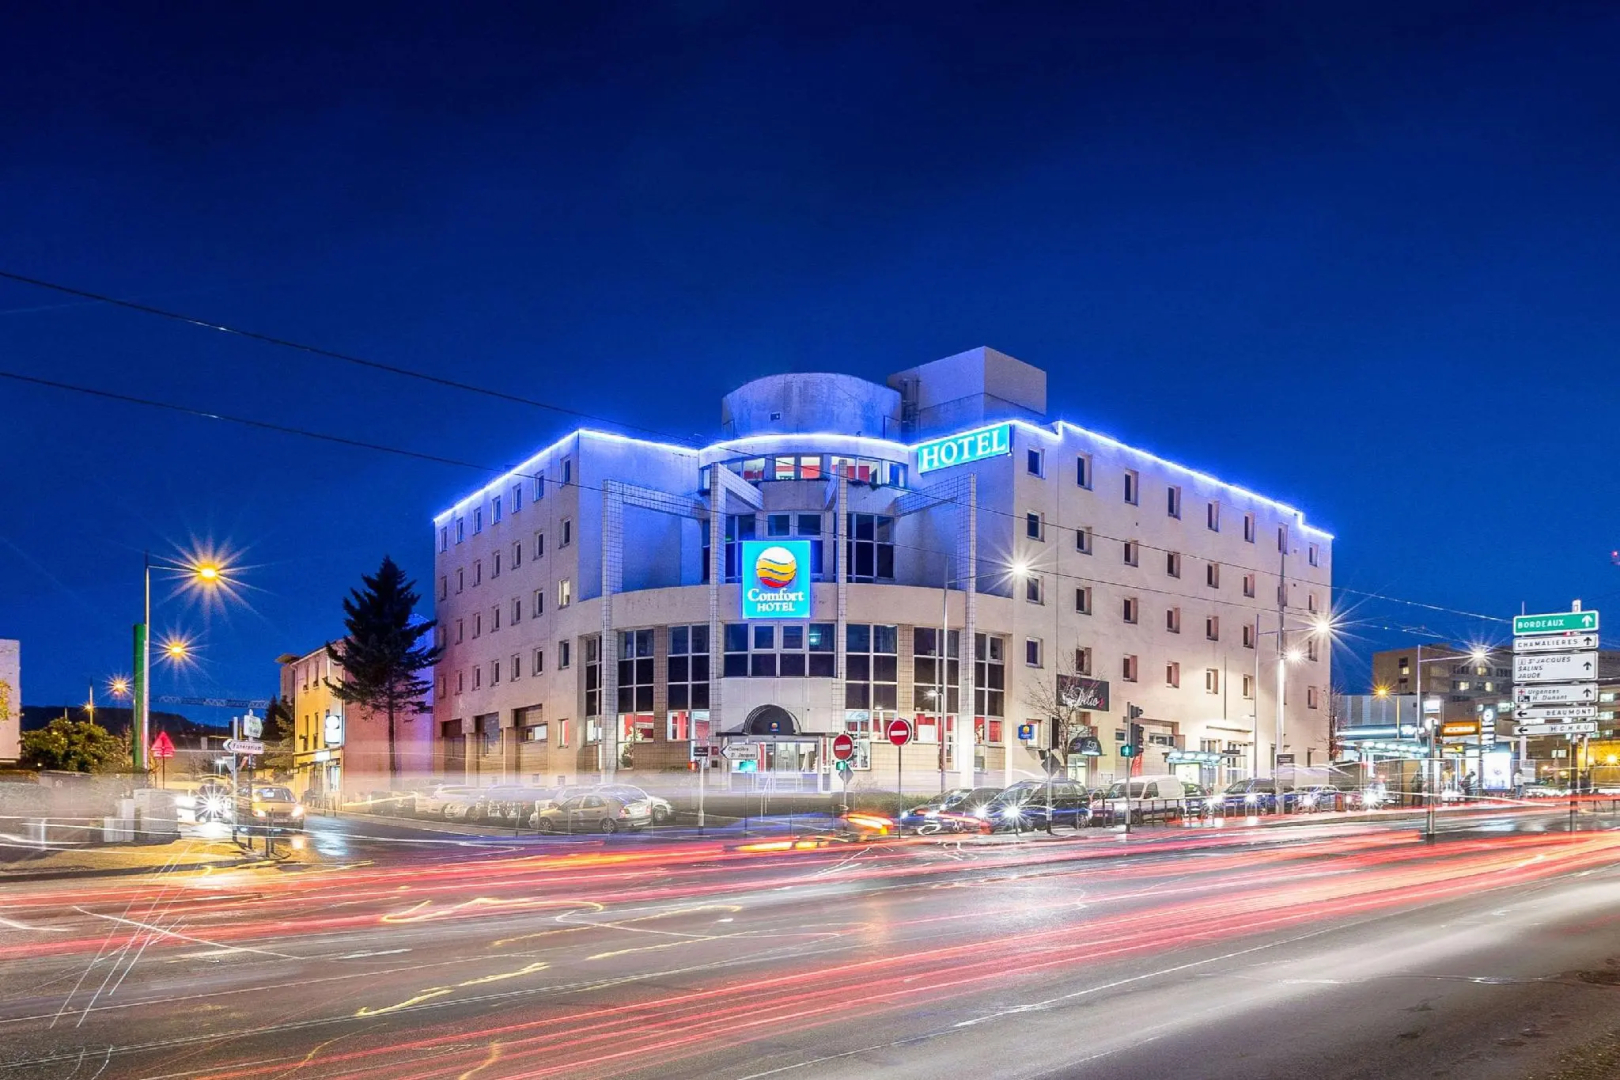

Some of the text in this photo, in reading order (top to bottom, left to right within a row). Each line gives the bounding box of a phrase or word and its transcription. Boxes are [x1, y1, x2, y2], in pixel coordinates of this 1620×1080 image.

[921, 429, 1006, 470] HOTEL
[747, 587, 805, 602] Comfort
[756, 602, 796, 613] HOTEL
[1517, 619, 1565, 629] BORDEAUX
[1546, 708, 1592, 716] BEAUMONT
